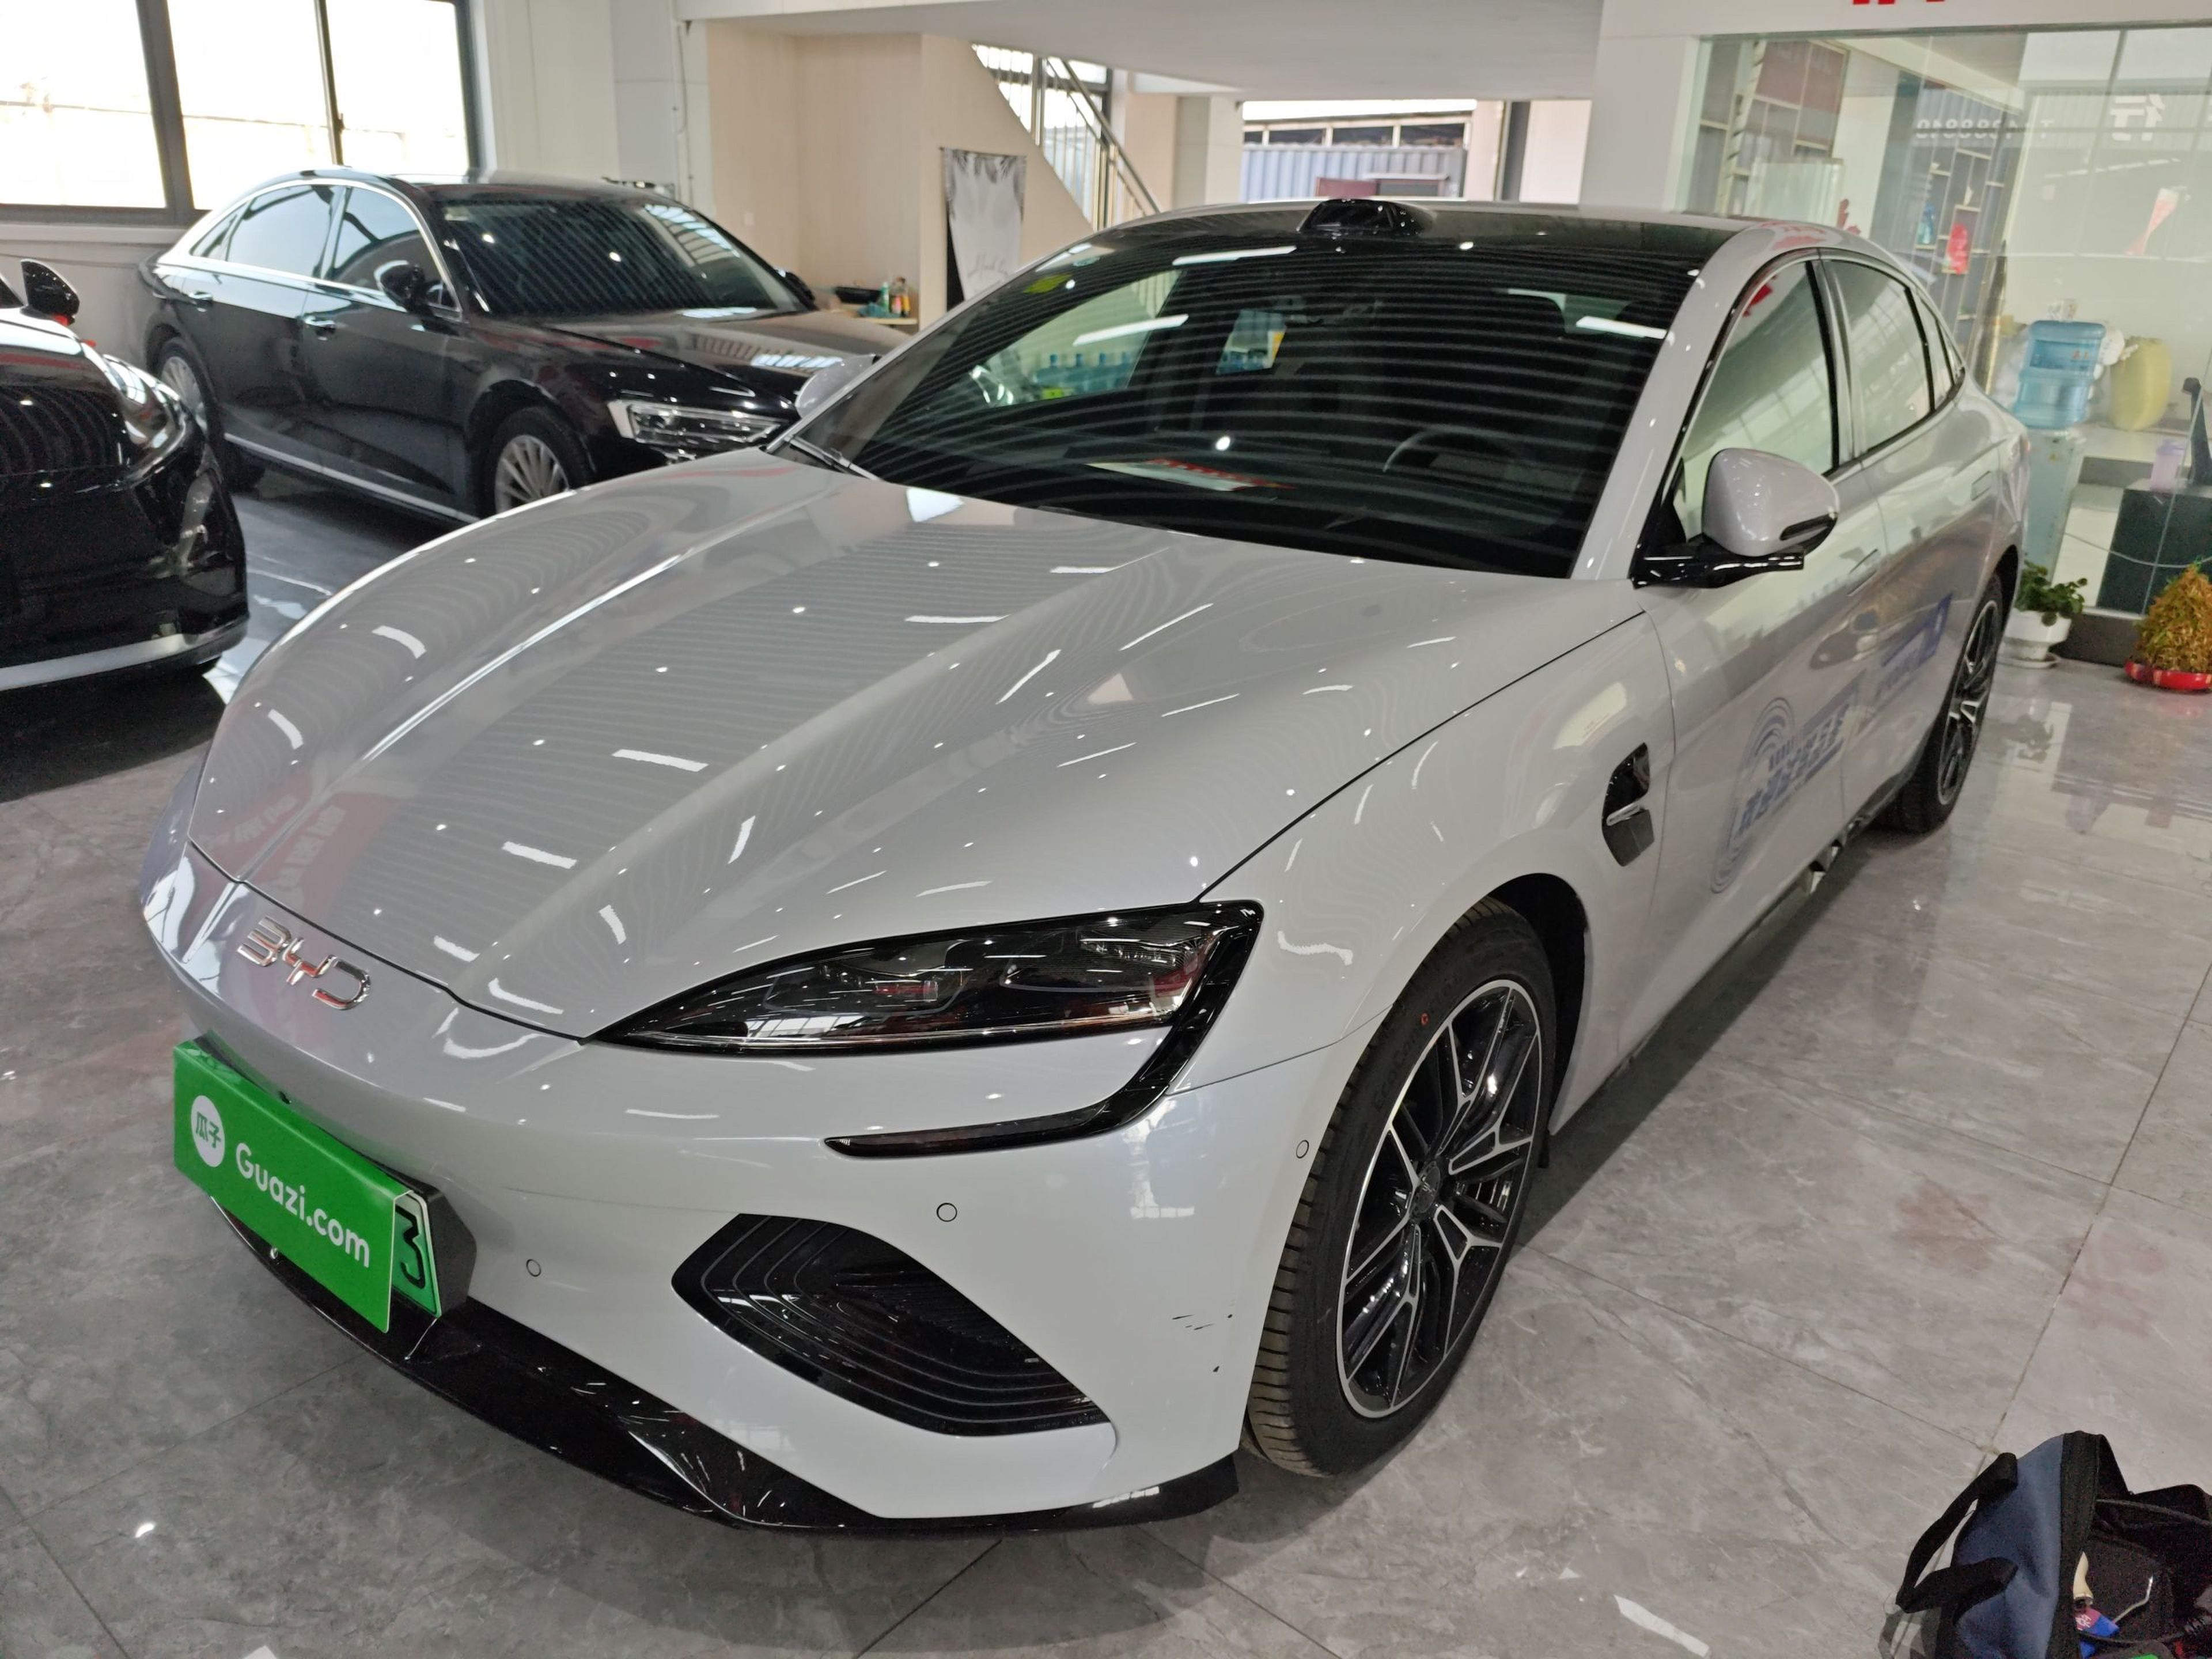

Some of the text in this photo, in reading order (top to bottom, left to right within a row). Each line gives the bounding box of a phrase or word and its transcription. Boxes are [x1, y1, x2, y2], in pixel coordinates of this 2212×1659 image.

[237, 916, 370, 1010] BYD
[196, 1111, 222, 1149] 瓜子
[236, 1142, 370, 1268] Guazi.com
